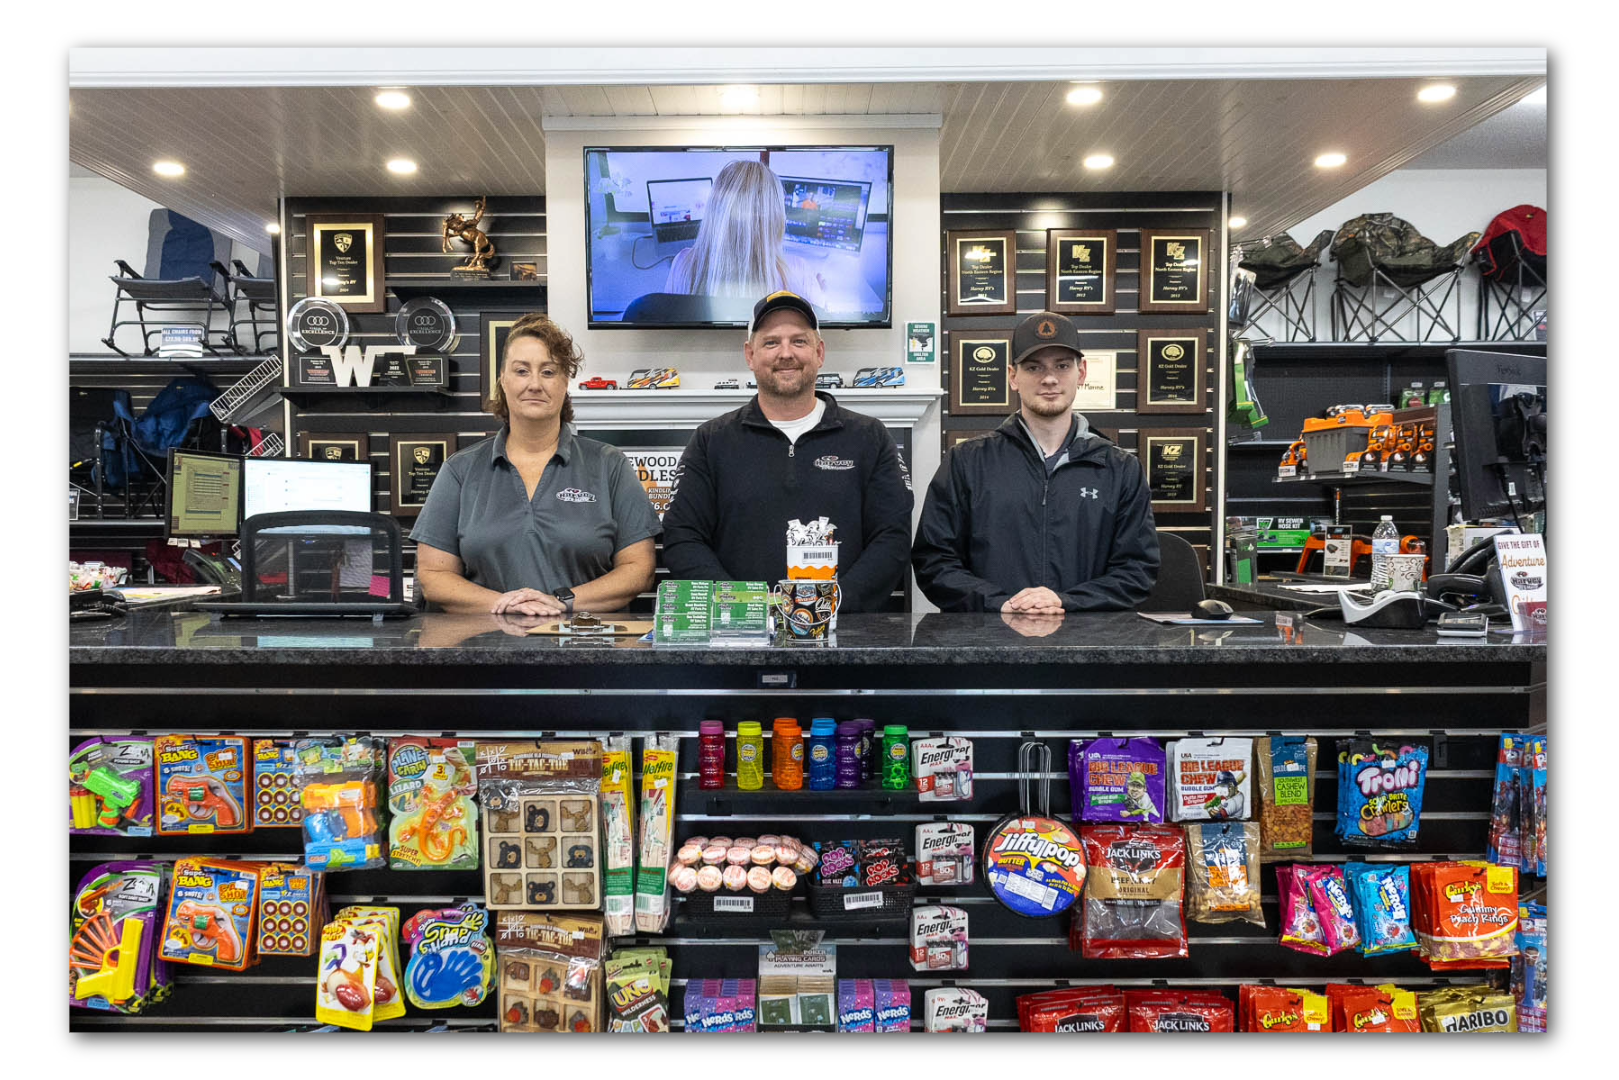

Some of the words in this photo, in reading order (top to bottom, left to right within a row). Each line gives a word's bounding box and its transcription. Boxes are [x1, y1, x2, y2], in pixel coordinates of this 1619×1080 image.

[635, 470, 677, 481] DLES
[1498, 541, 1510, 549] GIVE
[1510, 541, 1520, 549] THE
[1521, 540, 1532, 549] GIFT
[1533, 540, 1540, 548] OF
[1502, 554, 1545, 569] Adventure
[165, 744, 189, 752] Super
[161, 750, 198, 763] BANG
[391, 747, 431, 773] PLANET
[920, 745, 970, 766] Energir
[397, 761, 427, 776] EARTH
[508, 758, 569, 772] TIC-TAC-TOE
[1089, 761, 1109, 773] BIG
[1110, 761, 1158, 776] LEAGUE
[1180, 761, 1200, 772] BIG
[1201, 759, 1245, 772] LEAGUE
[918, 779, 928, 787] 12
[1089, 774, 1127, 786] CHEW
[1180, 773, 1217, 785] CHEW
[1357, 760, 1419, 795] Trolli
[390, 780, 422, 795] LIZARD
[1280, 790, 1301, 798] BLEND
[1388, 792, 1407, 801] BRITE
[1361, 801, 1408, 820] Crawlers
[923, 831, 971, 850] Energir
[400, 845, 419, 856] SUPER
[822, 847, 846, 865] POP
[1106, 848, 1131, 859] JACK
[821, 857, 855, 877] ROCKS
[866, 859, 890, 876] POP
[997, 858, 1026, 866] BUTTER
[178, 876, 212, 887] BANG
[263, 879, 284, 887] BANG
[866, 865, 900, 887] ROCKS
[1459, 905, 1498, 915] Gummy
[917, 917, 966, 936] Energi
[1451, 914, 1479, 924] Peach
[1480, 913, 1509, 926] Rings
[431, 932, 472, 951] Hand
[775, 954, 802, 962] PLAYING
[803, 954, 827, 962] CARDS
[613, 982, 653, 1006] UNO
[621, 994, 657, 1017] WILDERNESS
[935, 1003, 986, 1017] Energir
[1154, 1019, 1177, 1031] JACK
[1446, 1009, 1509, 1032] HARIBO
